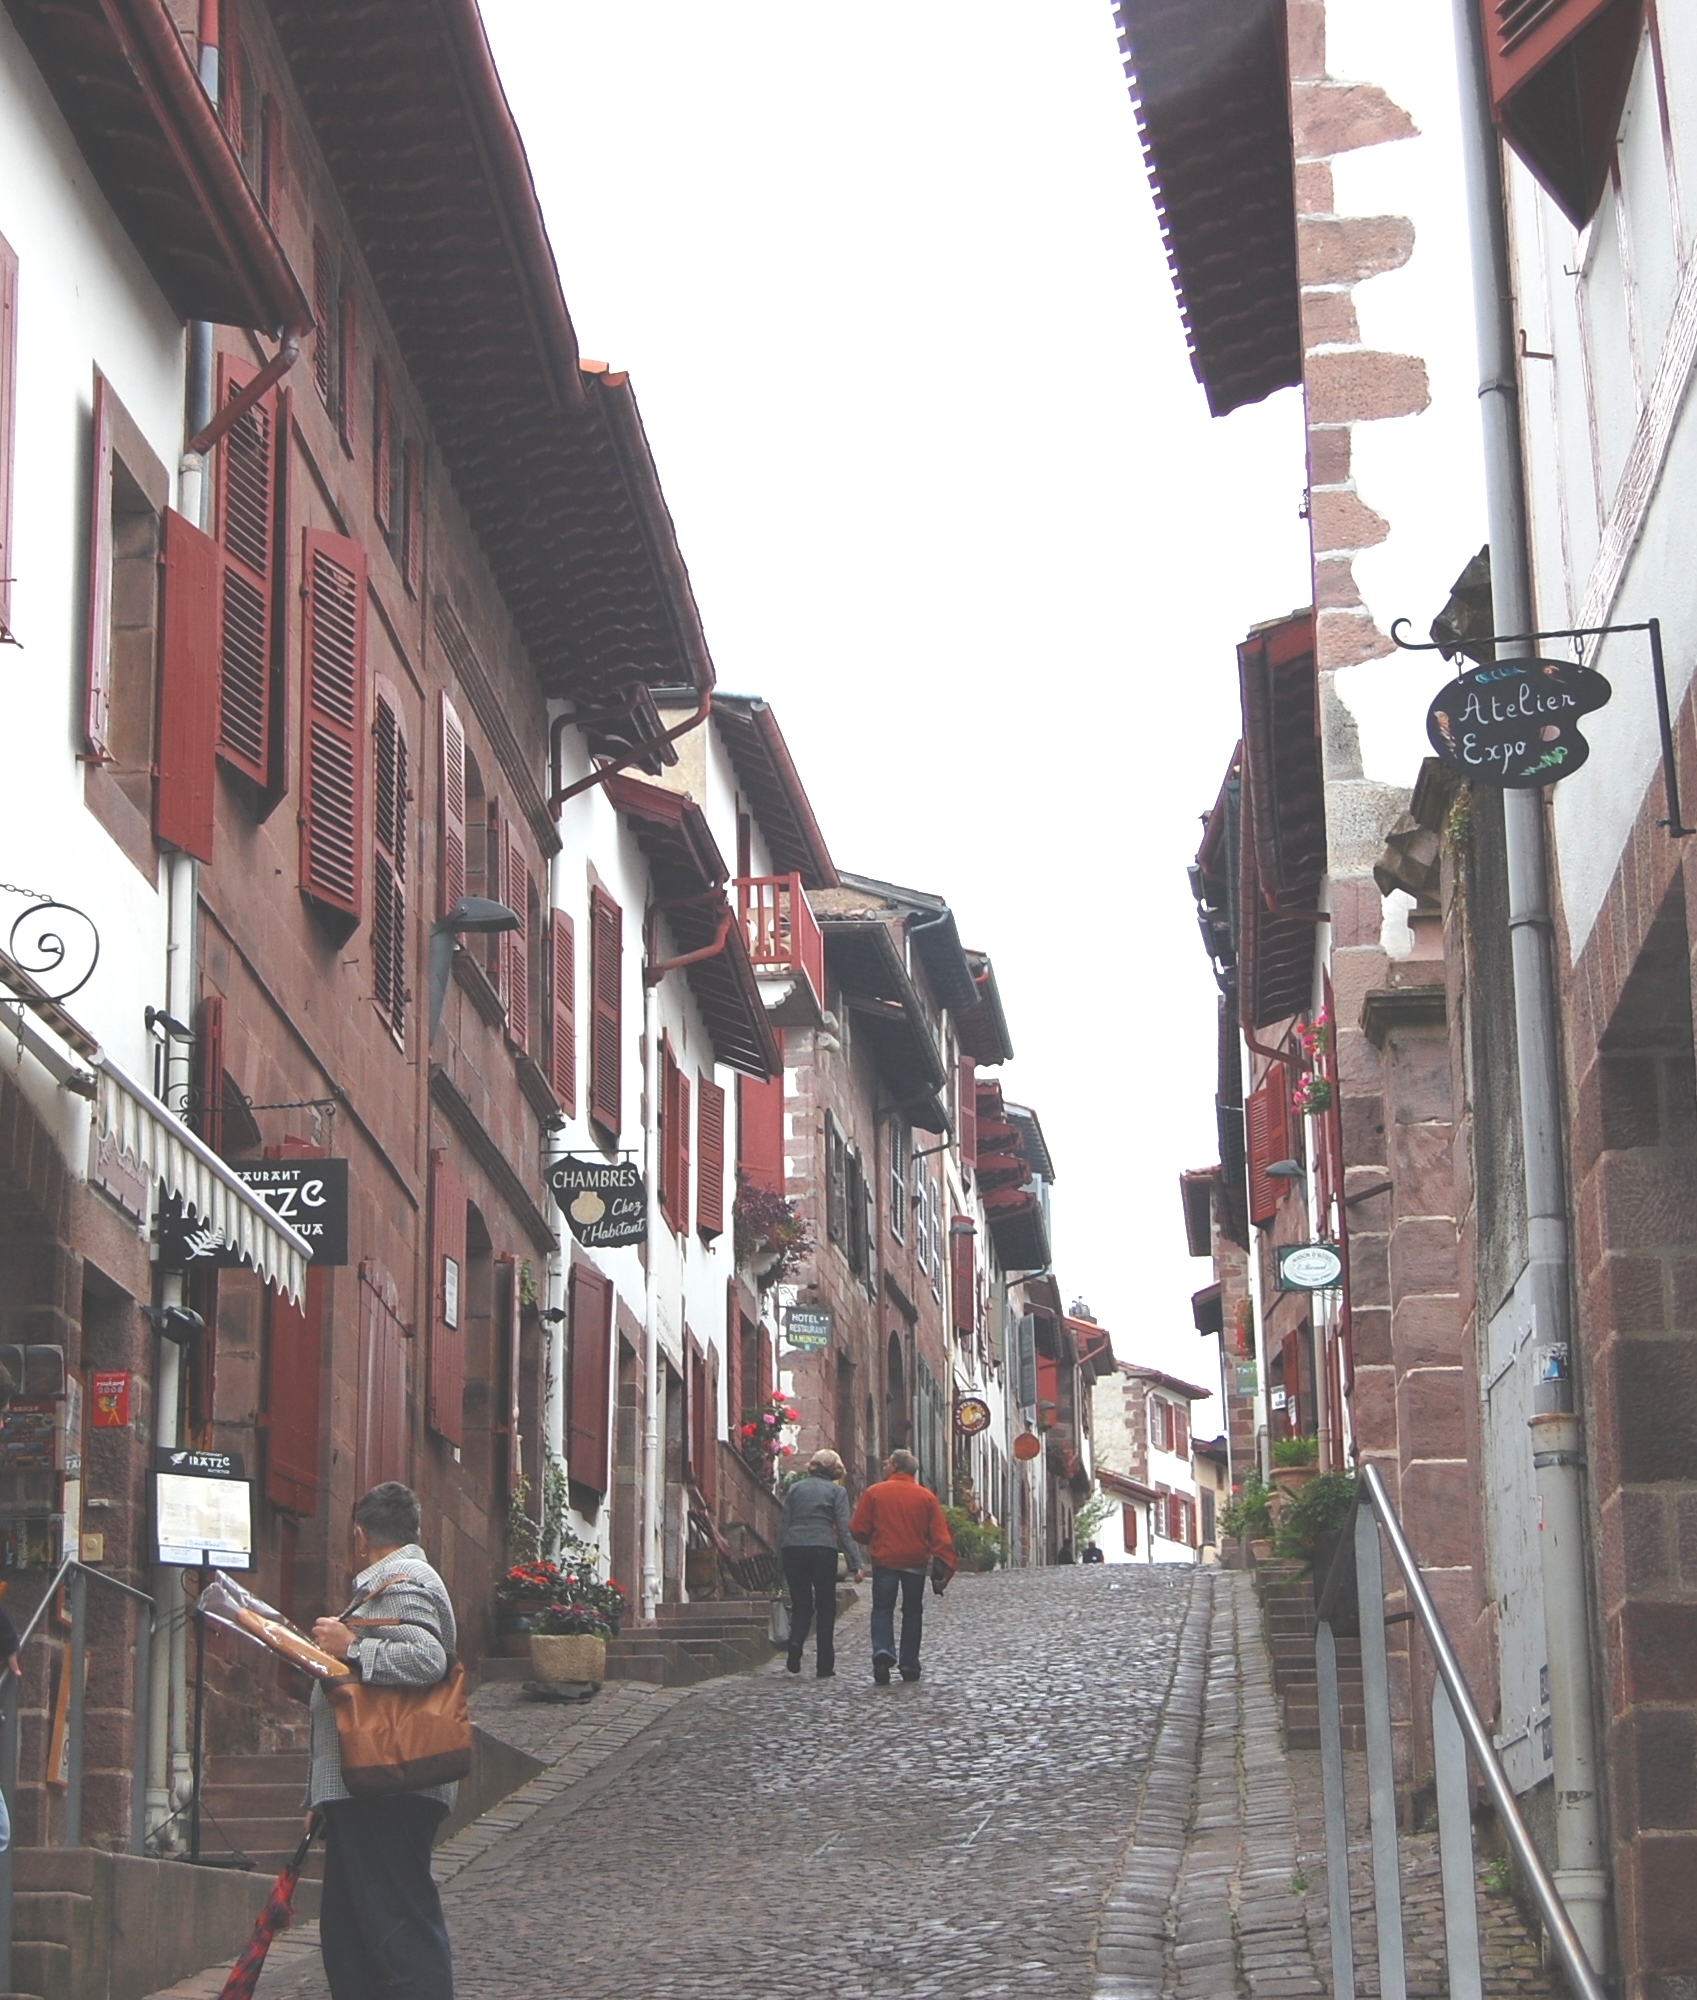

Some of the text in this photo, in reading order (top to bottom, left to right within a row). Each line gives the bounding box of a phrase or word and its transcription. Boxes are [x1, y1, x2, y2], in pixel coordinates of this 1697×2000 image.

[1458, 683, 1576, 725] Atelier
[1462, 732, 1527, 775] Expo
[234, 1170, 301, 1182] AURANT
[552, 1169, 636, 1189] CHAMBRES
[611, 1197, 643, 1217] Chez
[580, 1218, 646, 1244] l'Habitant
[792, 1313, 819, 1323] HOTEL
